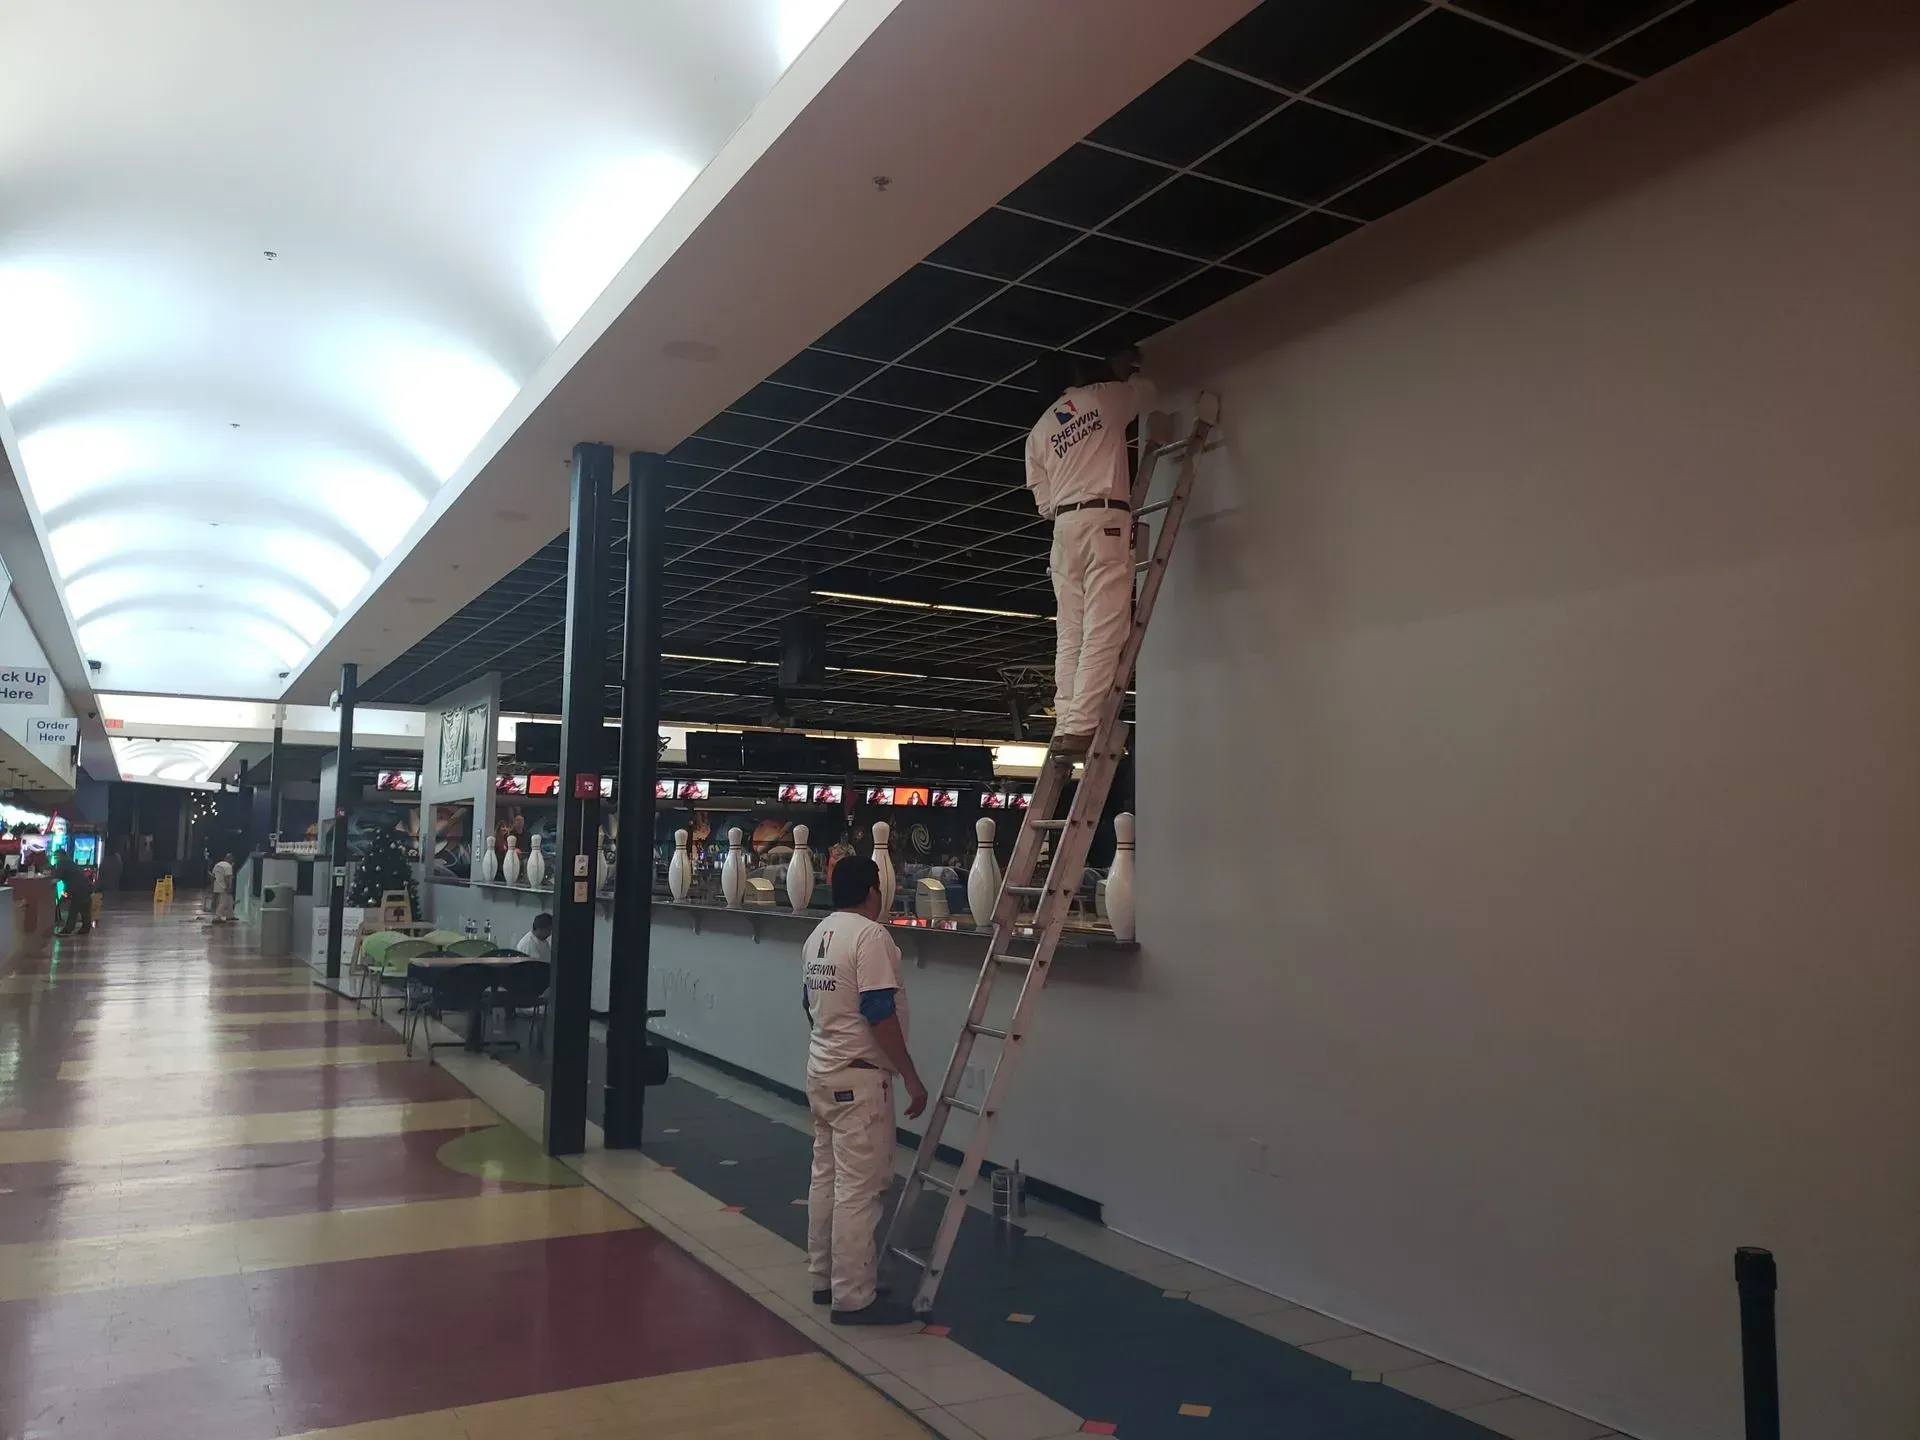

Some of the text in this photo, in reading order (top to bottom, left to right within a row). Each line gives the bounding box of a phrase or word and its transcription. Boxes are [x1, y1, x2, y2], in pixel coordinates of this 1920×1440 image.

[1050, 409, 1099, 448] SHERWIN
[1054, 420, 1103, 459] WLLIAMS
[0, 671, 47, 686] ck Up
[36, 720, 70, 730] Order
[39, 732, 66, 742] Here
